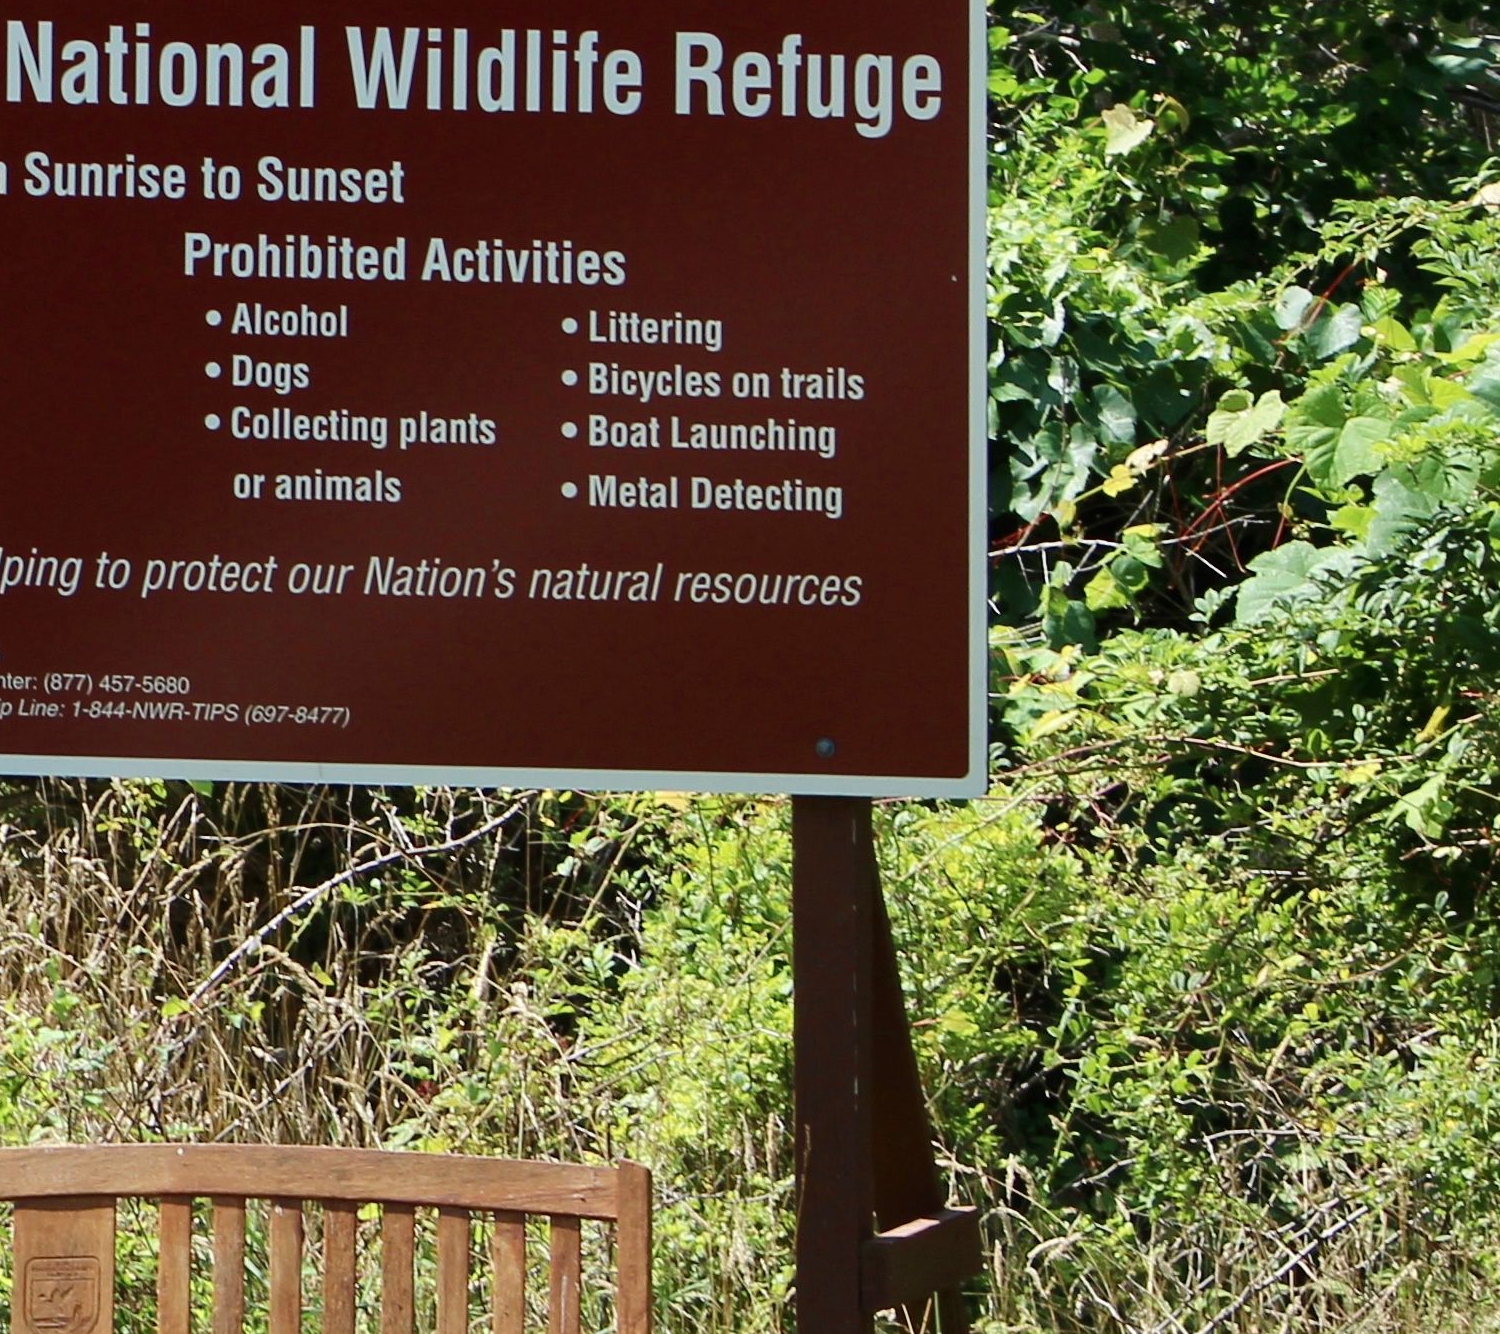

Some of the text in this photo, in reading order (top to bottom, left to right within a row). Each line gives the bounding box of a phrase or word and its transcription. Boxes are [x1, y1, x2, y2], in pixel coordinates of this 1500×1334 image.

[6, 20, 315, 109] National
[345, 25, 642, 116] Wildlife
[675, 31, 942, 139] Refuge
[23, 151, 186, 199] Sunrise
[200, 156, 241, 201] to
[257, 155, 405, 204] Sunset
[184, 231, 626, 286] Prohibited Activities
[230, 302, 348, 337] Alcohol
[589, 309, 722, 352] Littering
[232, 354, 310, 395] Dogs
[588, 362, 865, 403] Bicycles on trails
[231, 405, 496, 450] Collecting plants
[588, 414, 836, 459] Boat Launching
[233, 468, 402, 503] or animals
[588, 474, 843, 519] Metal Detecting
[95, 551, 131, 589] to
[140, 554, 278, 599] protect
[287, 563, 355, 595] our
[528, 562, 664, 602] natural
[673, 572, 863, 607] resources
[43, 672, 93, 695] (877)
[98, 674, 190, 695] 457-5680
[17, 698, 66, 718] Line:
[72, 700, 240, 722] 1-844-NWR-TIPS
[244, 704, 351, 728] (697-8477)
